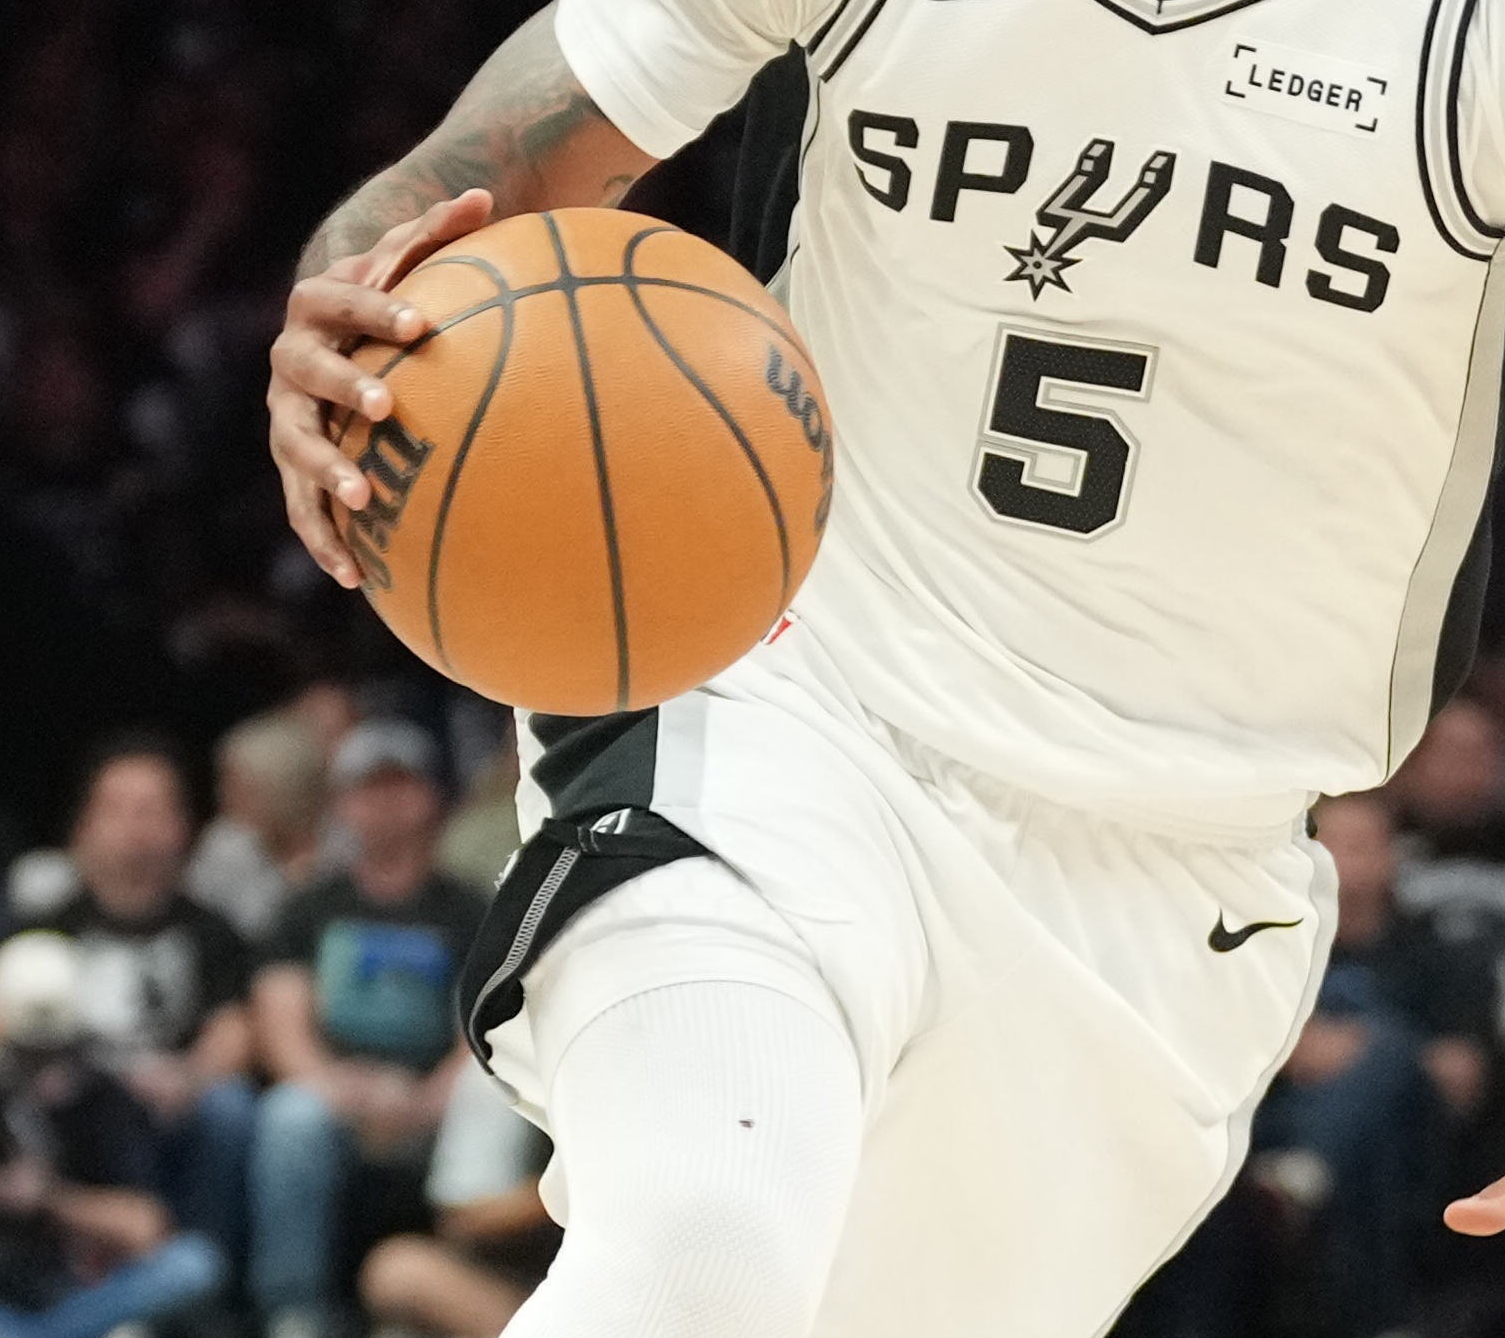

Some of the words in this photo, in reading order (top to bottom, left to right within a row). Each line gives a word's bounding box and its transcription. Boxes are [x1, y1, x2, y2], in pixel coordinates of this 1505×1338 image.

[1248, 63, 1363, 113] LEDGER
[847, 109, 1401, 314] SPURS
[967, 322, 1159, 543] 5
